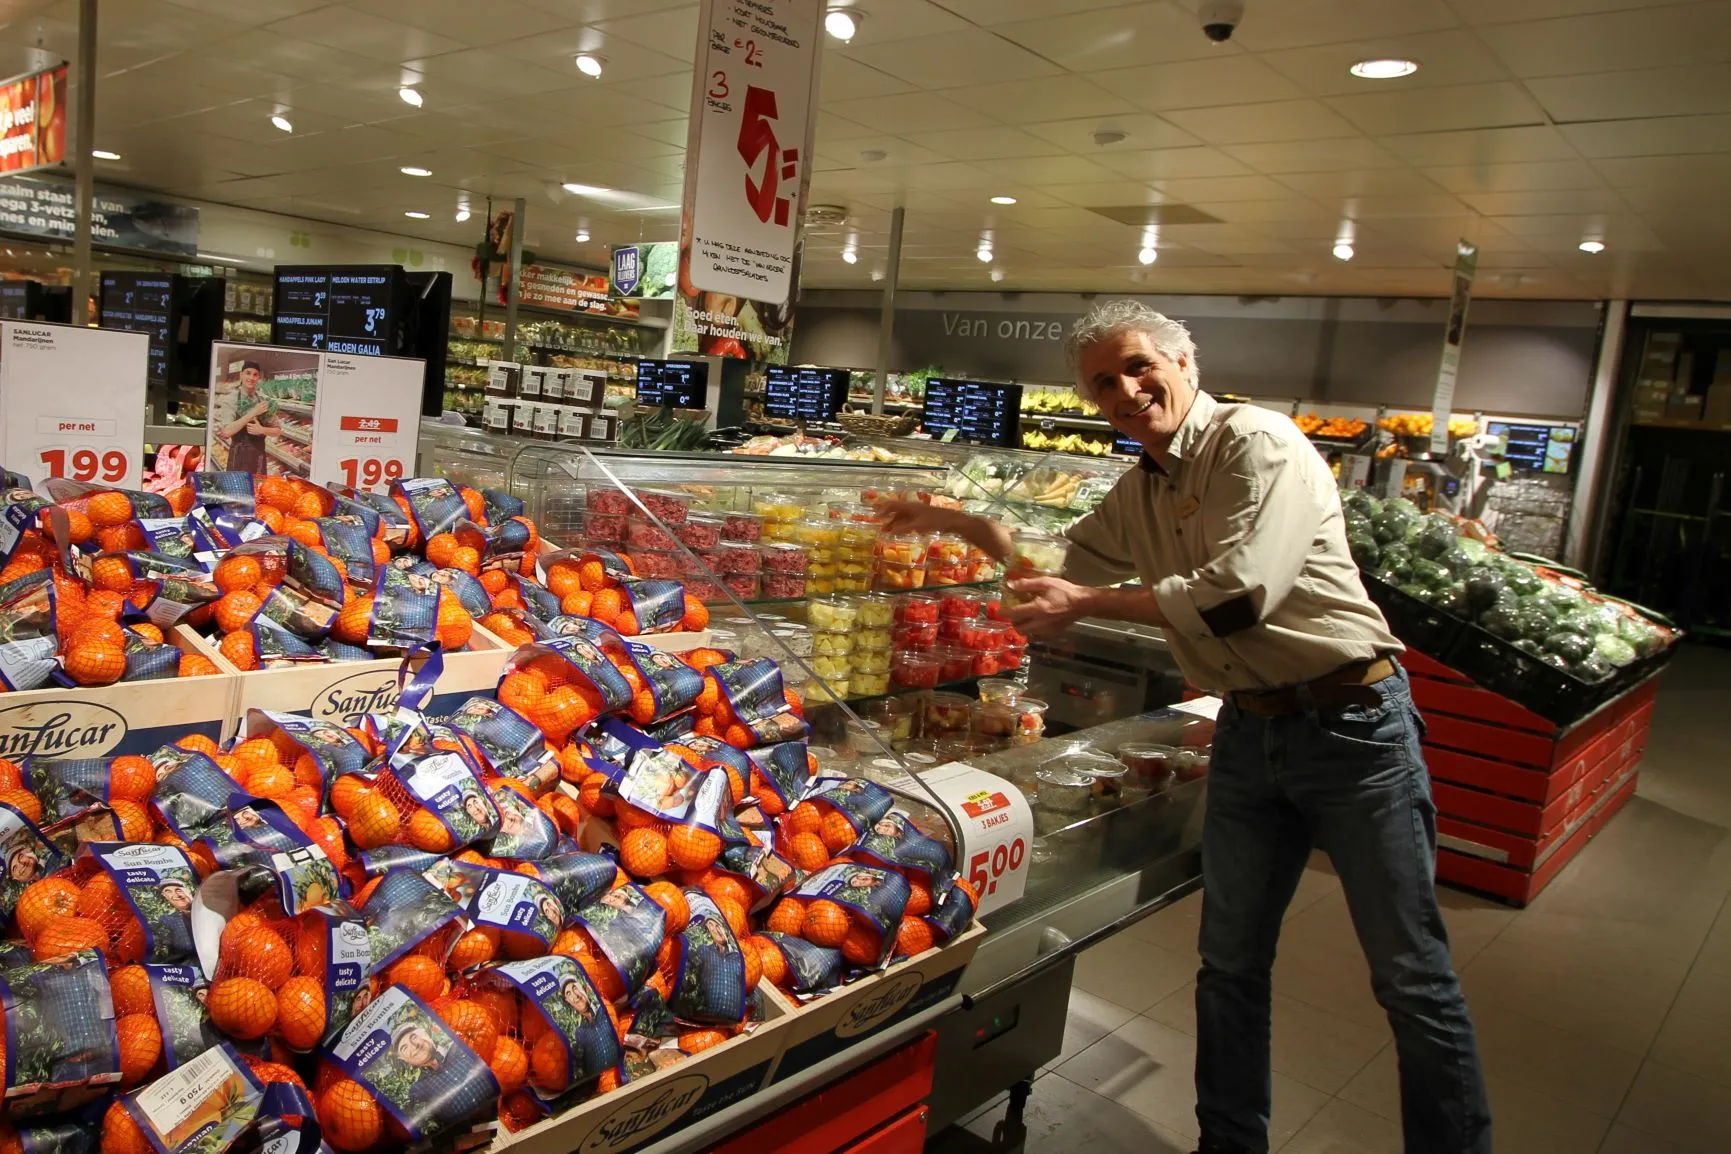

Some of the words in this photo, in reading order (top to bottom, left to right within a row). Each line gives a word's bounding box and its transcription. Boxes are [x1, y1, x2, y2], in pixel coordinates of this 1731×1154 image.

[709, 71, 728, 98] 3
[37, 188, 72, 204] staat
[28, 216, 46, 228] en
[618, 253, 635, 270] LAAG
[527, 281, 564, 294] gesneden
[524, 290, 532, 300] je
[544, 294, 562, 302] mee
[563, 297, 577, 306] aan
[578, 298, 588, 308] de
[590, 301, 606, 312] slag.
[684, 306, 713, 322] Goed
[714, 311, 739, 326] eten.
[13, 328, 51, 337] SANLUCAR
[943, 312, 988, 336] Van
[998, 320, 1062, 340] onze
[682, 322, 708, 336] Daar
[710, 324, 747, 341] houden
[750, 333, 762, 344] we
[764, 336, 783, 347] van.
[328, 342, 356, 353] MELOEN
[358, 342, 380, 356] GALIA
[59, 422, 76, 432] per
[78, 422, 96, 432] net
[355, 436, 368, 444] per
[370, 436, 382, 444] net
[426, 714, 450, 724] Taste
[435, 790, 450, 803] tasty
[437, 794, 460, 810] delicate
[981, 820, 986, 829] 3
[986, 813, 1008, 828] BAKJES
[144, 858, 173, 866] Bombs
[968, 838, 1024, 900] 5.00
[501, 904, 511, 916] Sun
[508, 884, 520, 903] Bombs
[514, 907, 525, 920] tasty
[522, 906, 534, 926] delicate
[340, 950, 354, 959] Sun
[162, 975, 189, 983] delicate
[339, 968, 353, 976] tasty
[335, 978, 357, 987] delicate
[531, 976, 546, 987] tasty
[536, 981, 556, 996] delicate
[350, 1030, 367, 1048] Sun
[368, 1002, 394, 1030] Bombs
[356, 1038, 375, 1057] tasty
[358, 1040, 386, 1066] delicate
[187, 1084, 203, 1099] 750
